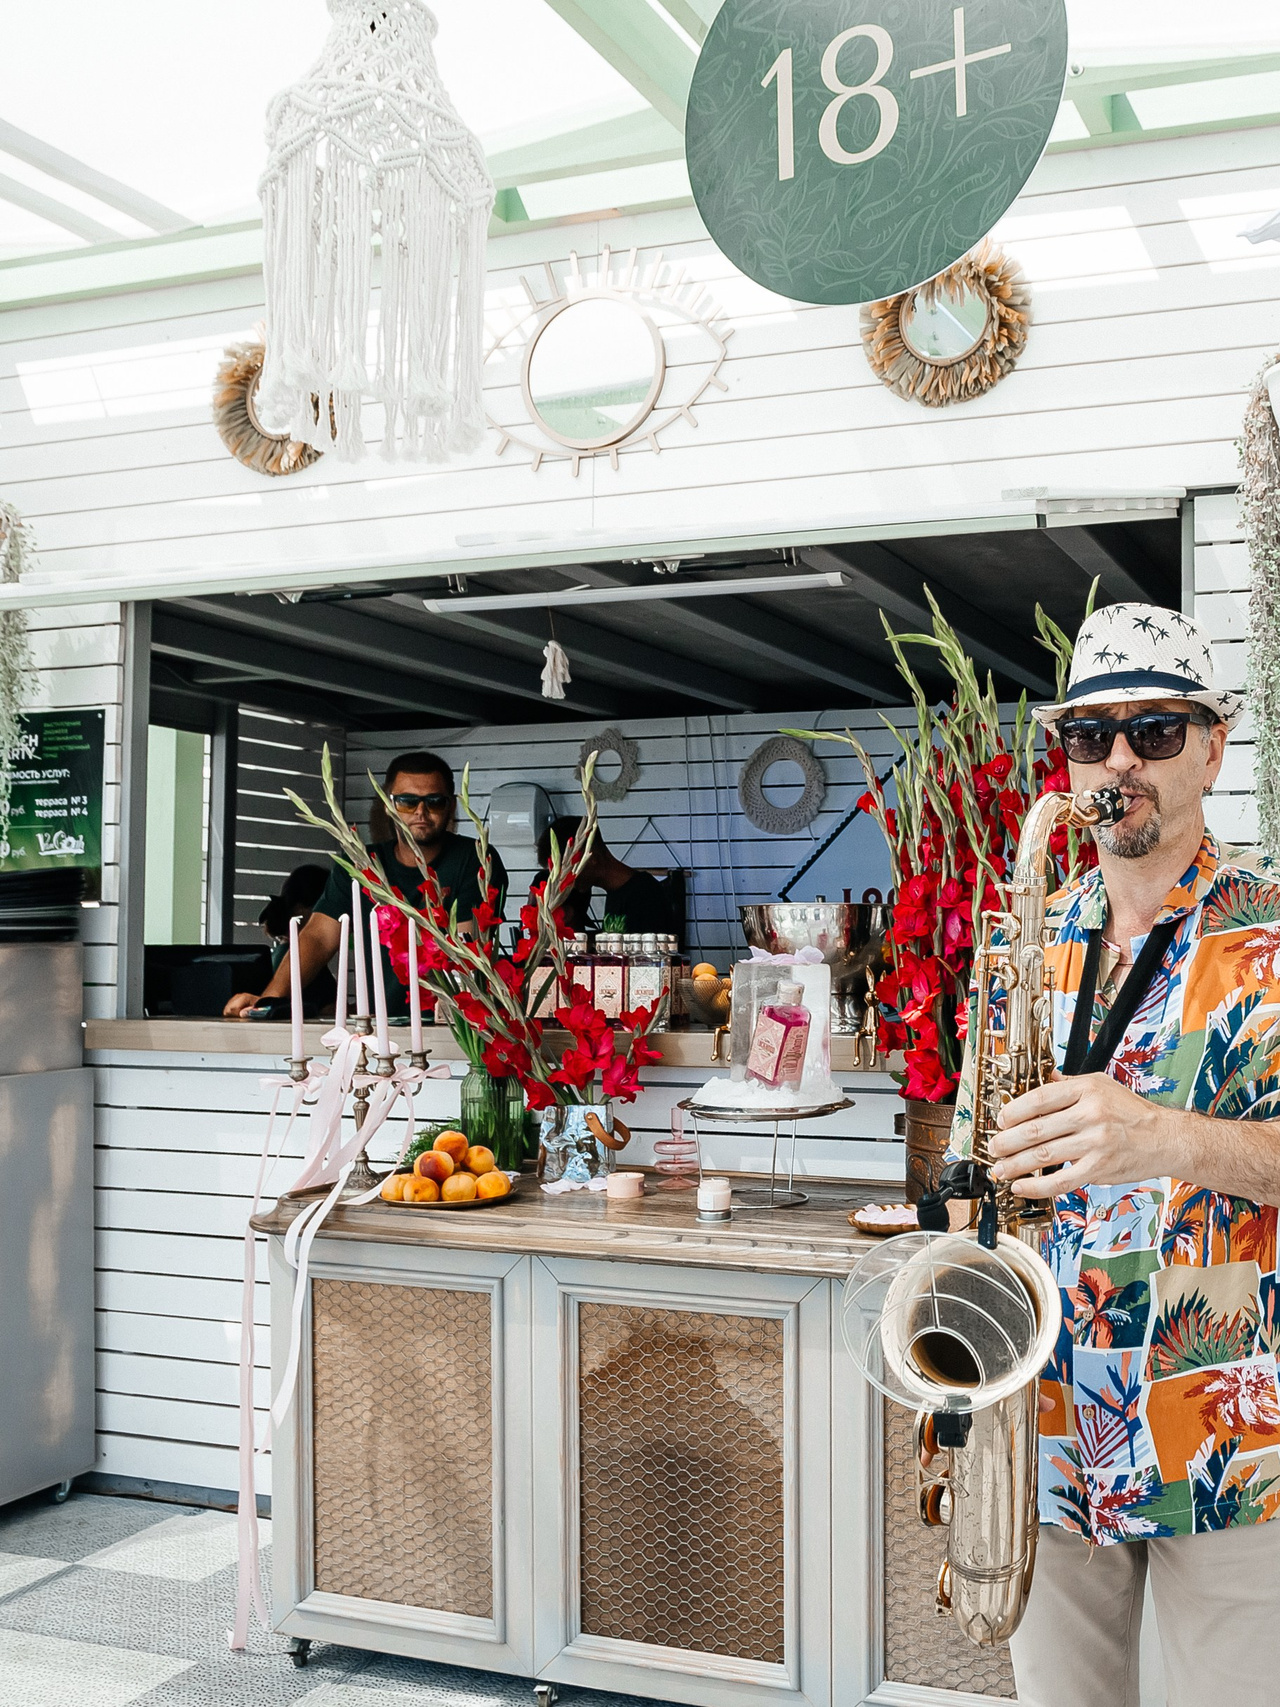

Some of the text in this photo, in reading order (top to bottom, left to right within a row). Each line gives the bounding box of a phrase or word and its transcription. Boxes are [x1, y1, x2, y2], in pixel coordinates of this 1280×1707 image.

[761, 7, 1011, 180] 18+
[1, 746, 36, 760] ARTY
[6, 770, 41, 779] МОСТЬ
[34, 798, 68, 808] терраса
[34, 809, 68, 819] терраса
